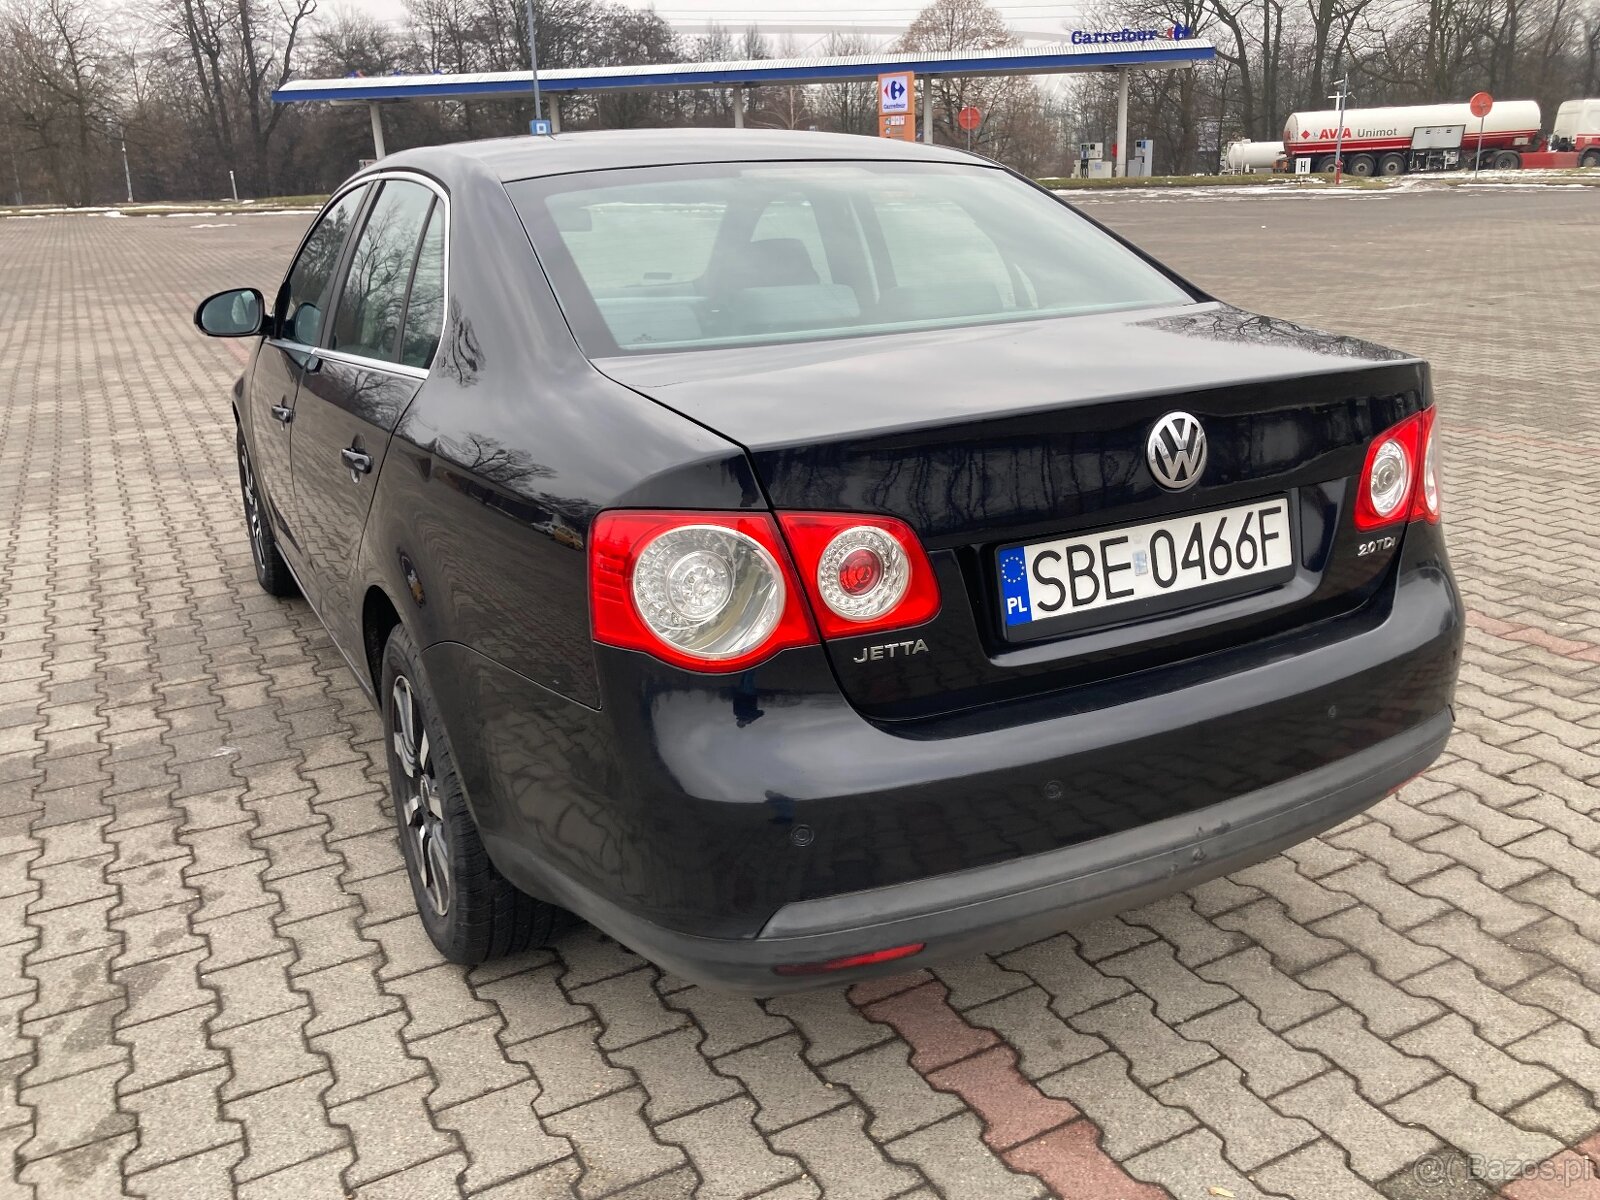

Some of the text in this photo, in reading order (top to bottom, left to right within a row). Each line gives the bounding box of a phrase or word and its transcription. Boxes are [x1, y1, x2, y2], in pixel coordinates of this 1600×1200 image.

[1071, 28, 1158, 45] Carrefour
[1319, 128, 1397, 140] AVA Unimot
[1300, 161, 1307, 173] H
[1032, 505, 1282, 612] SBE 0466F
[1007, 596, 1028, 615] PL
[853, 638, 930, 664] JETTA
